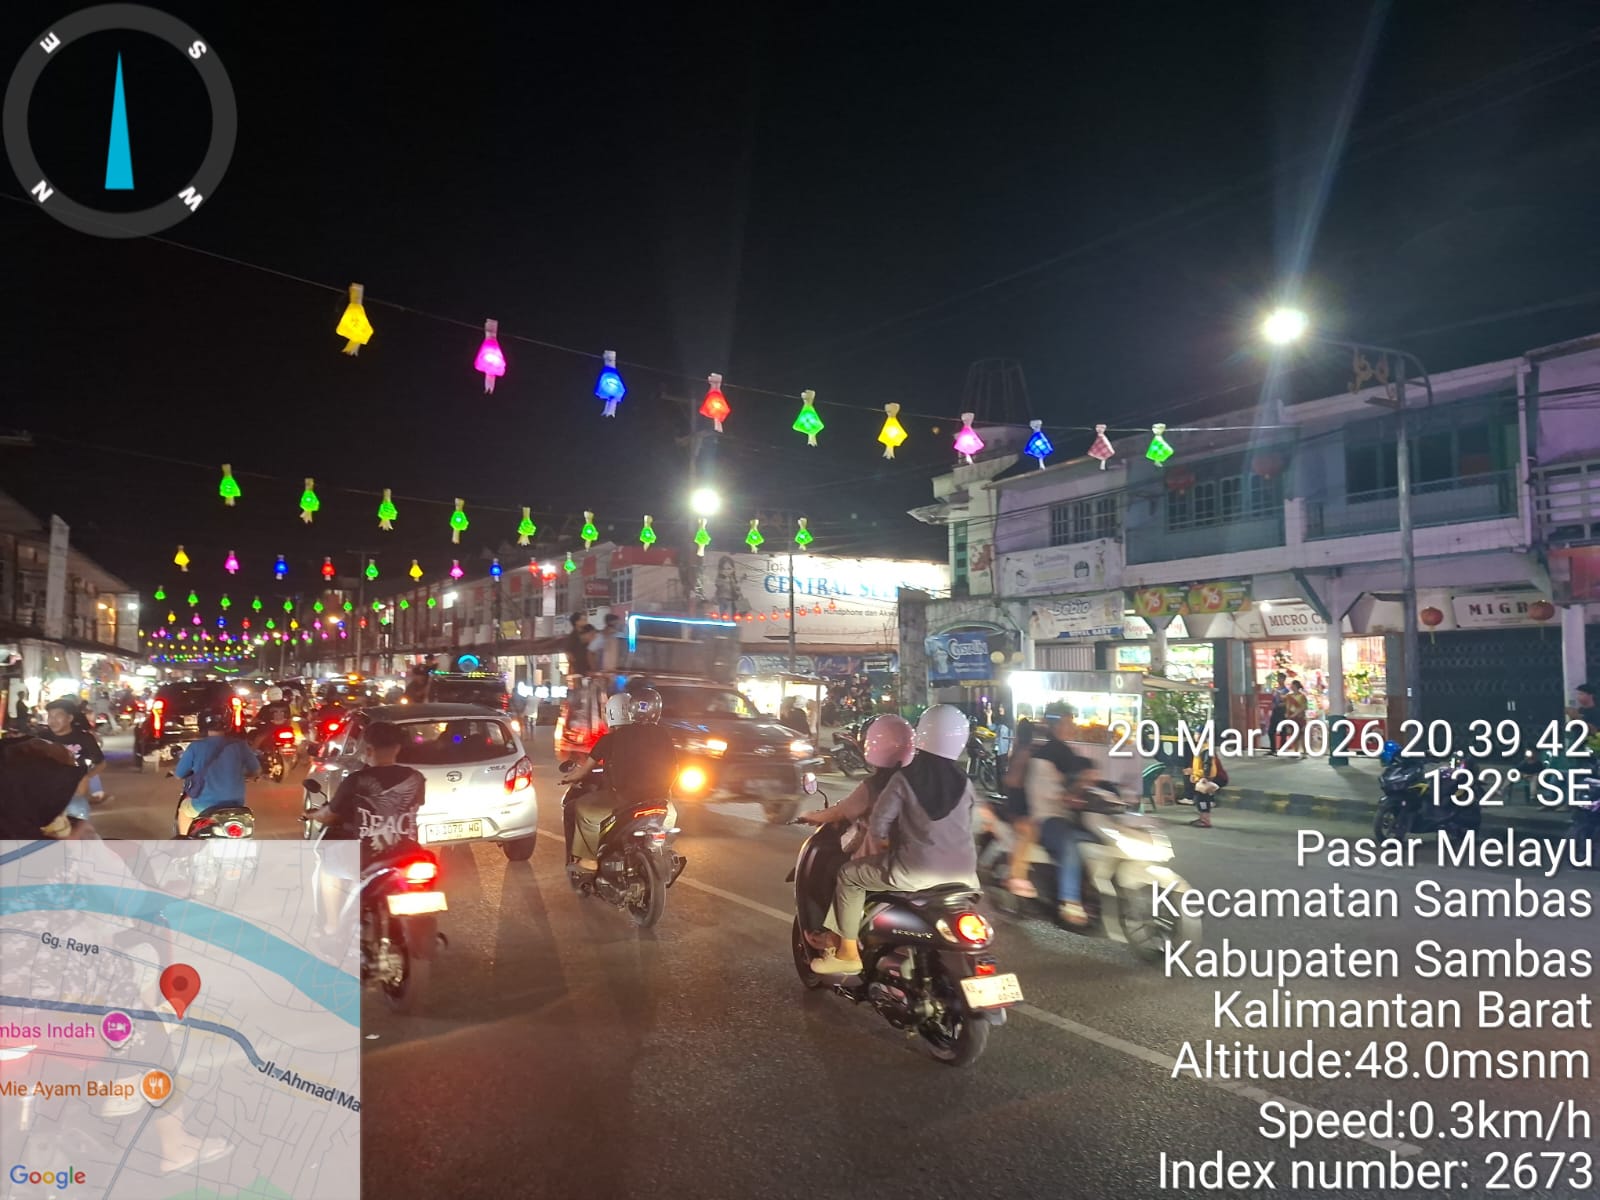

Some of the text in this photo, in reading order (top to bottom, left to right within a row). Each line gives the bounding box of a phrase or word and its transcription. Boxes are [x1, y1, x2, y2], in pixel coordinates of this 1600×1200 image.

[764, 575, 852, 596] CENTRAL
[1268, 613, 1308, 627] MICRO
[357, 807, 415, 836] TEAC
